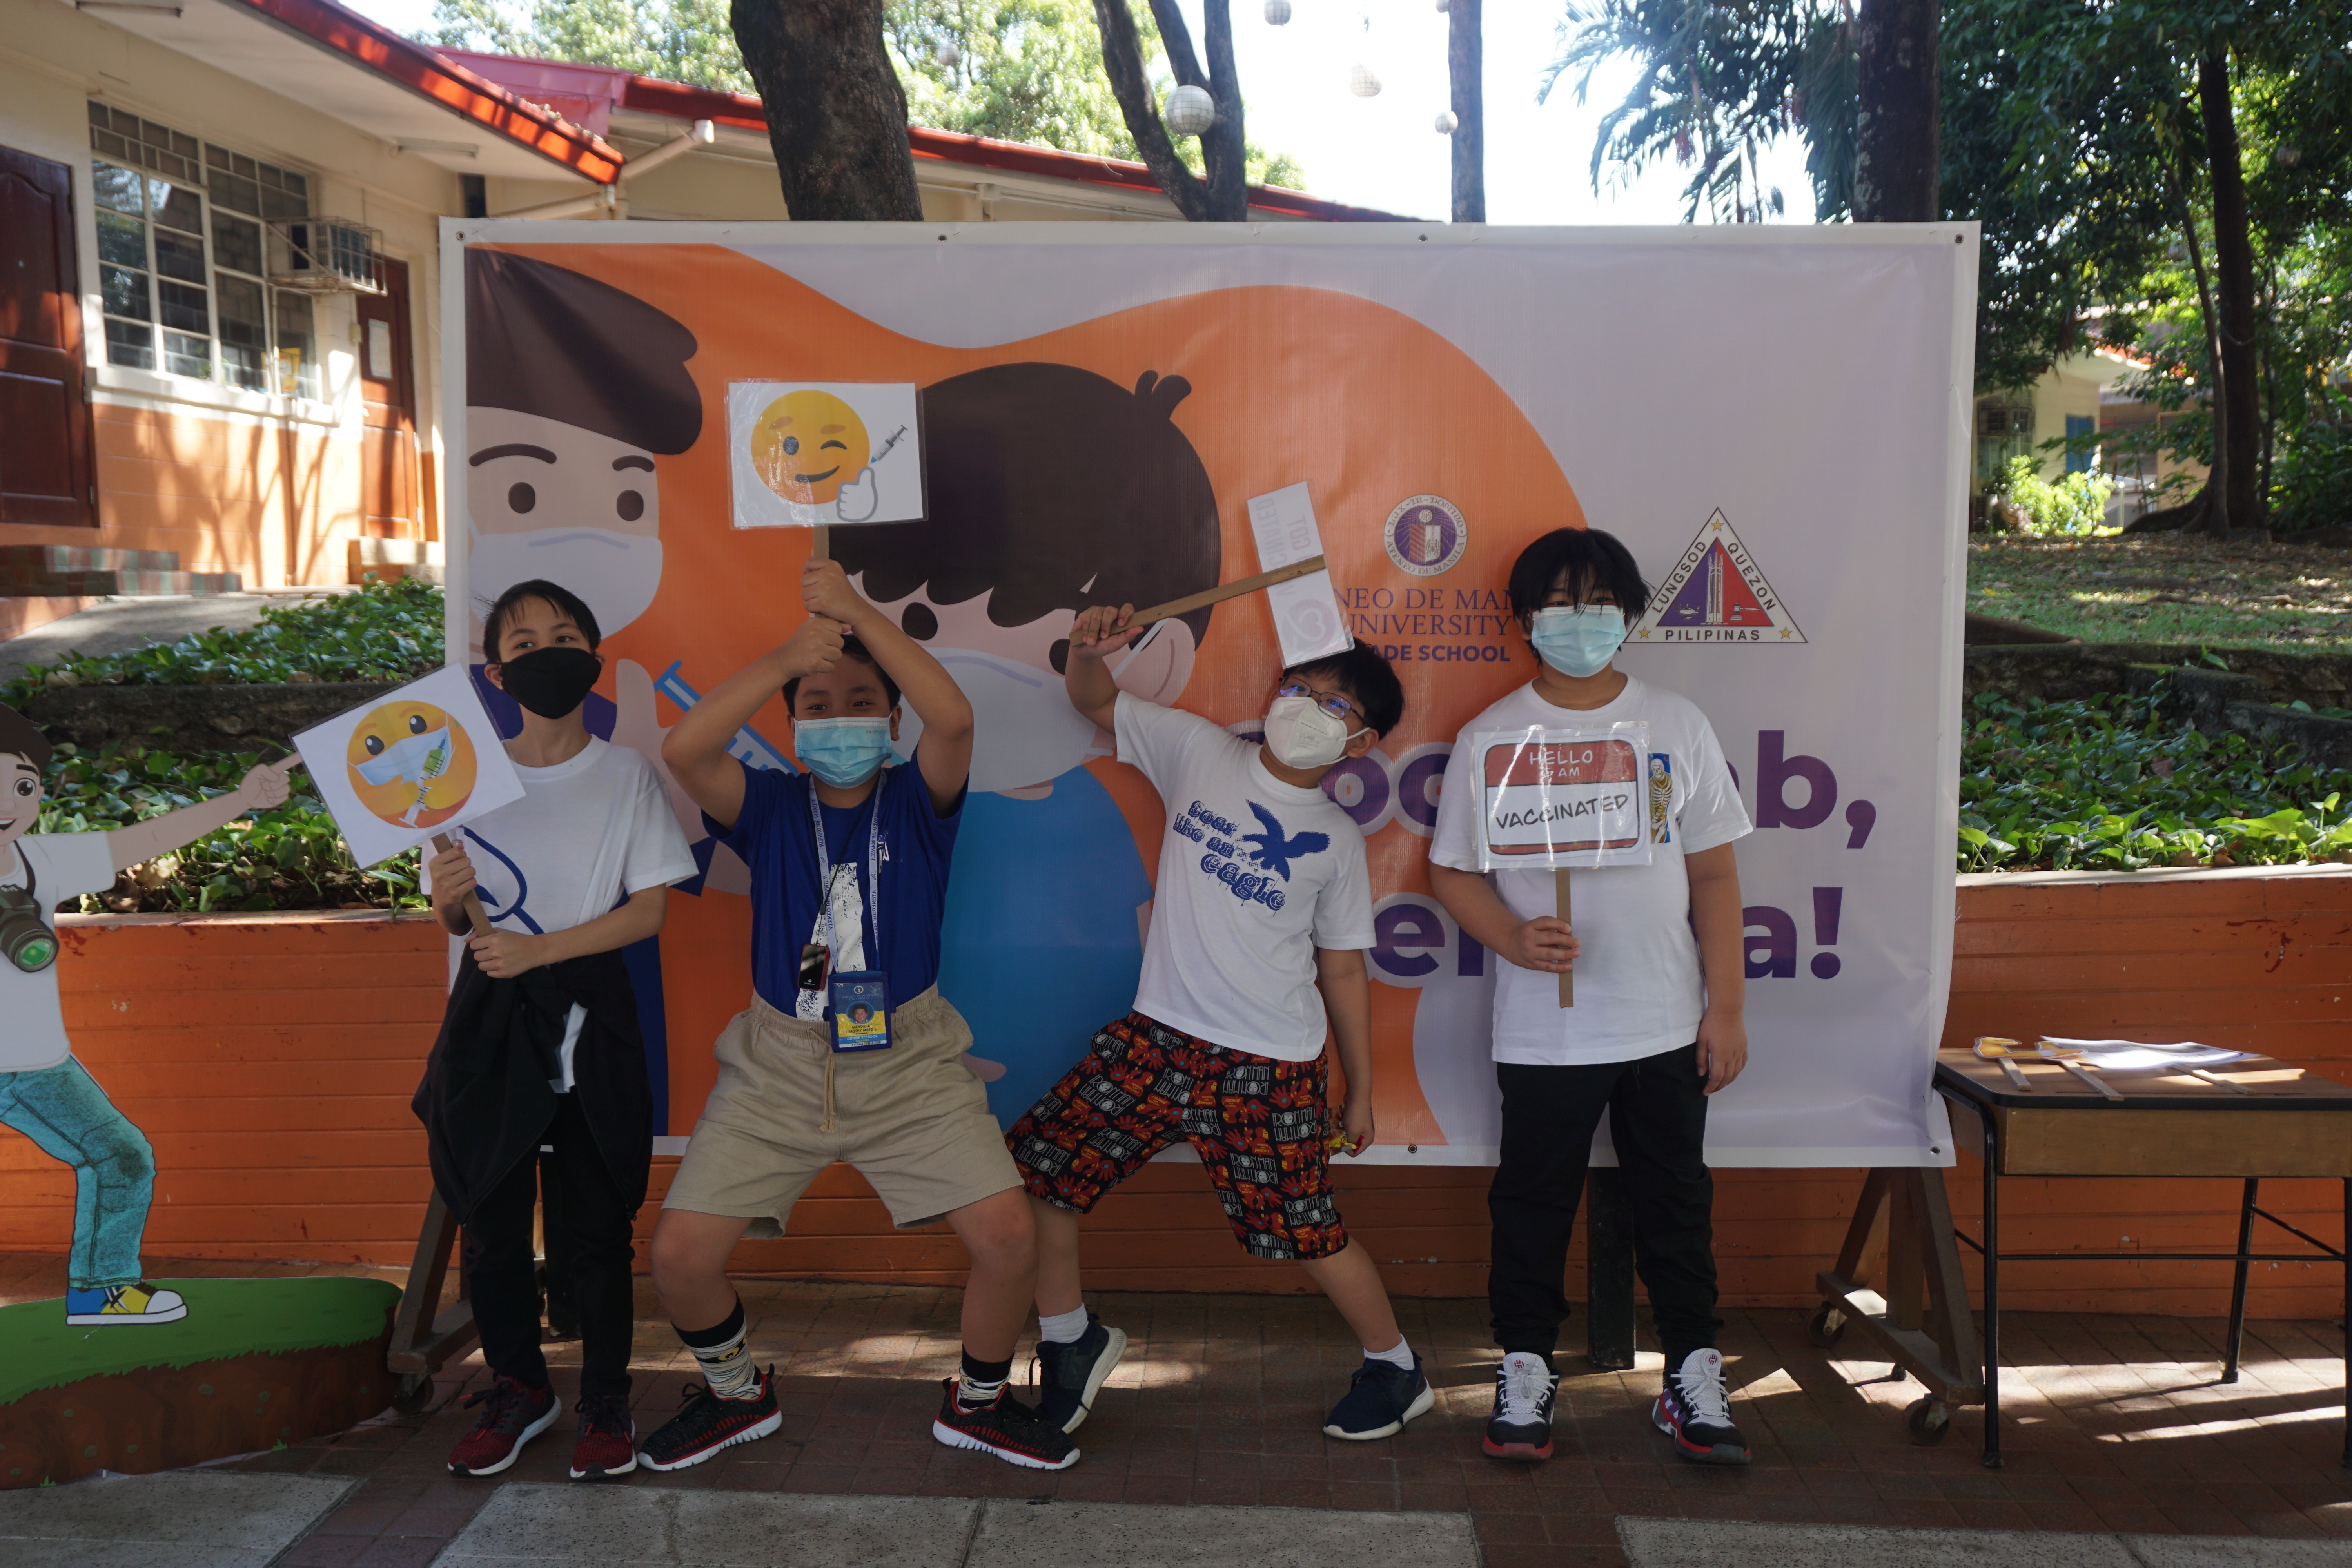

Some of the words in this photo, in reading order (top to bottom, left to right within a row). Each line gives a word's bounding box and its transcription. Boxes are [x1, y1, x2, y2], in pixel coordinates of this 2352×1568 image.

[1387, 541, 1416, 572] ATENEO
[1433, 541, 1465, 573] MANILA
[1651, 541, 1706, 613] LUNGSOD
[1727, 542, 1777, 611] QUEZON
[1405, 589, 1444, 609] DE
[1665, 630, 1760, 641] PILIPINAS
[1372, 644, 1412, 661] ADE
[1418, 645, 1510, 662] SCHOOL
[1529, 750, 1593, 766] HELLO
[1558, 766, 1581, 777] AM
[1496, 793, 1629, 829] VACCINATED
[1206, 837, 1235, 859] an
[1200, 853, 1286, 911] eagle
